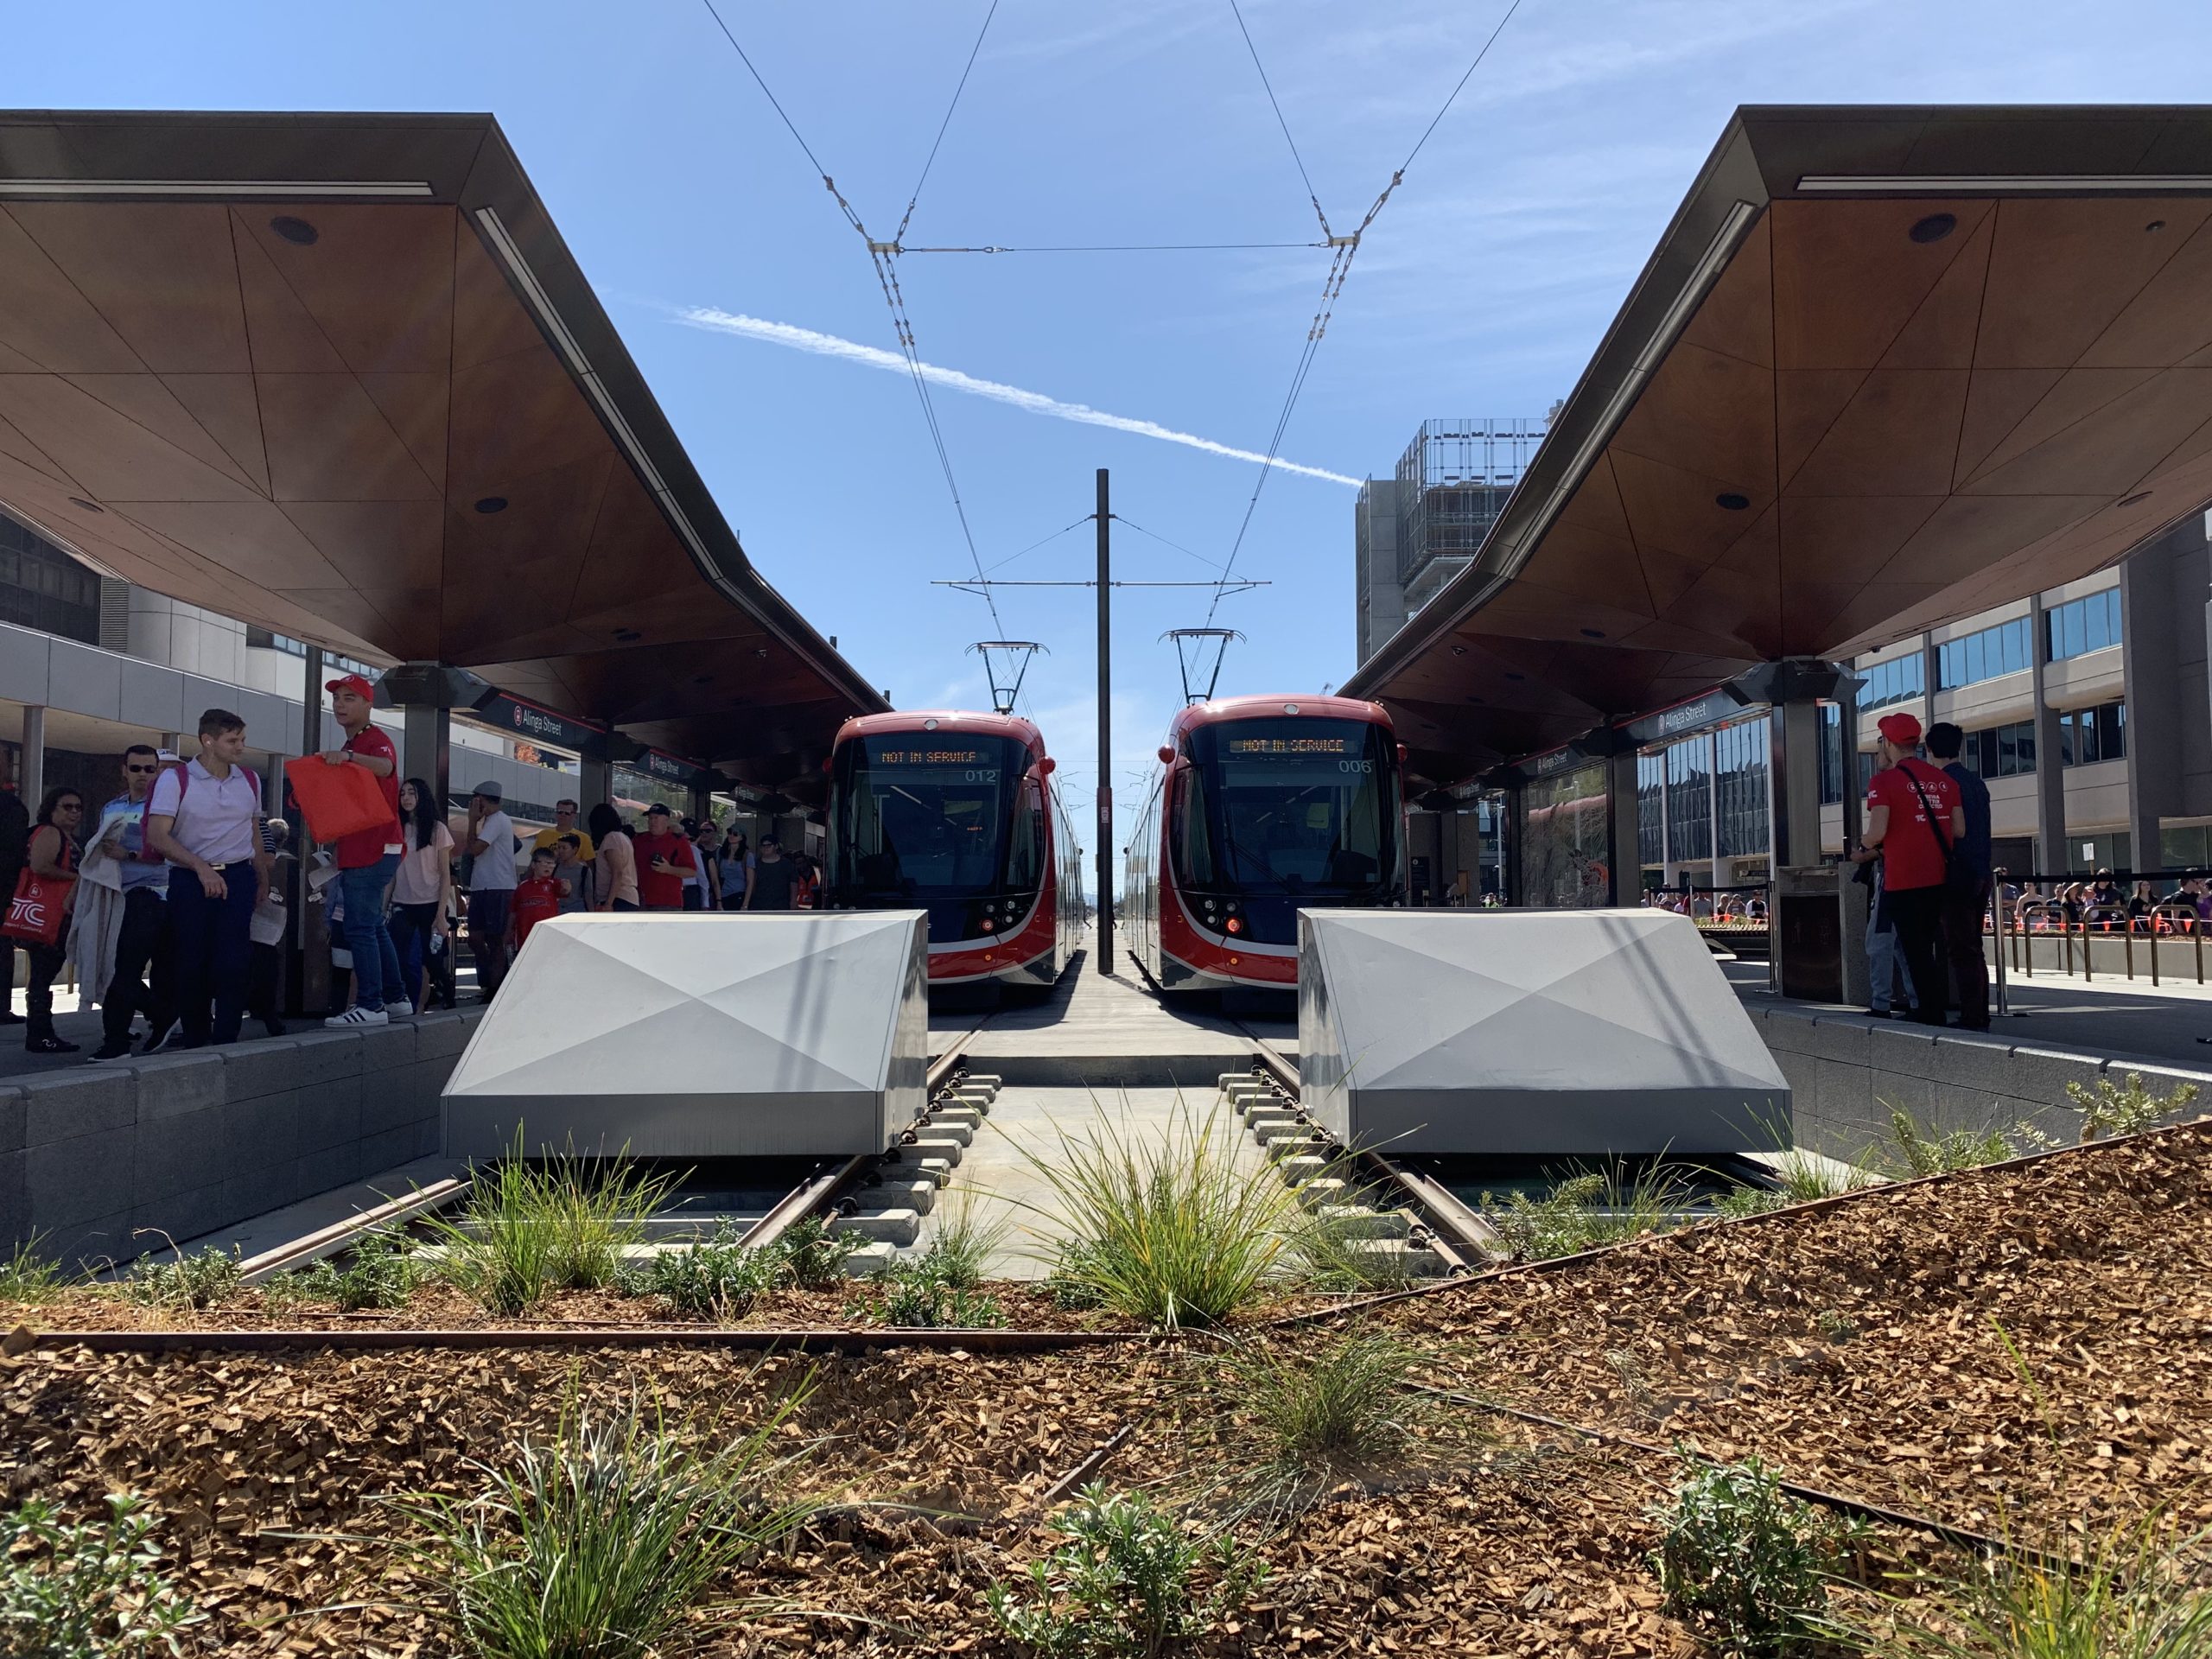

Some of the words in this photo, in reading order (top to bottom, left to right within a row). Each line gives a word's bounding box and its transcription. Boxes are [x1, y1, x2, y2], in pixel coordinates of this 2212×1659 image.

[1666, 712, 1685, 728] Alinga
[1685, 702, 1707, 721] Street
[523, 709, 543, 733] Alinga
[543, 716, 562, 736] Street
[1243, 740, 1267, 752] NOT
[1273, 740, 1286, 752] IN
[1290, 740, 1344, 752] SERVICE
[881, 752, 904, 762] NOT
[910, 752, 922, 762] IN
[926, 752, 976, 762] SERVICE
[1339, 760, 1372, 773] 006
[965, 769, 996, 782] 012
[11, 897, 46, 926] TC
